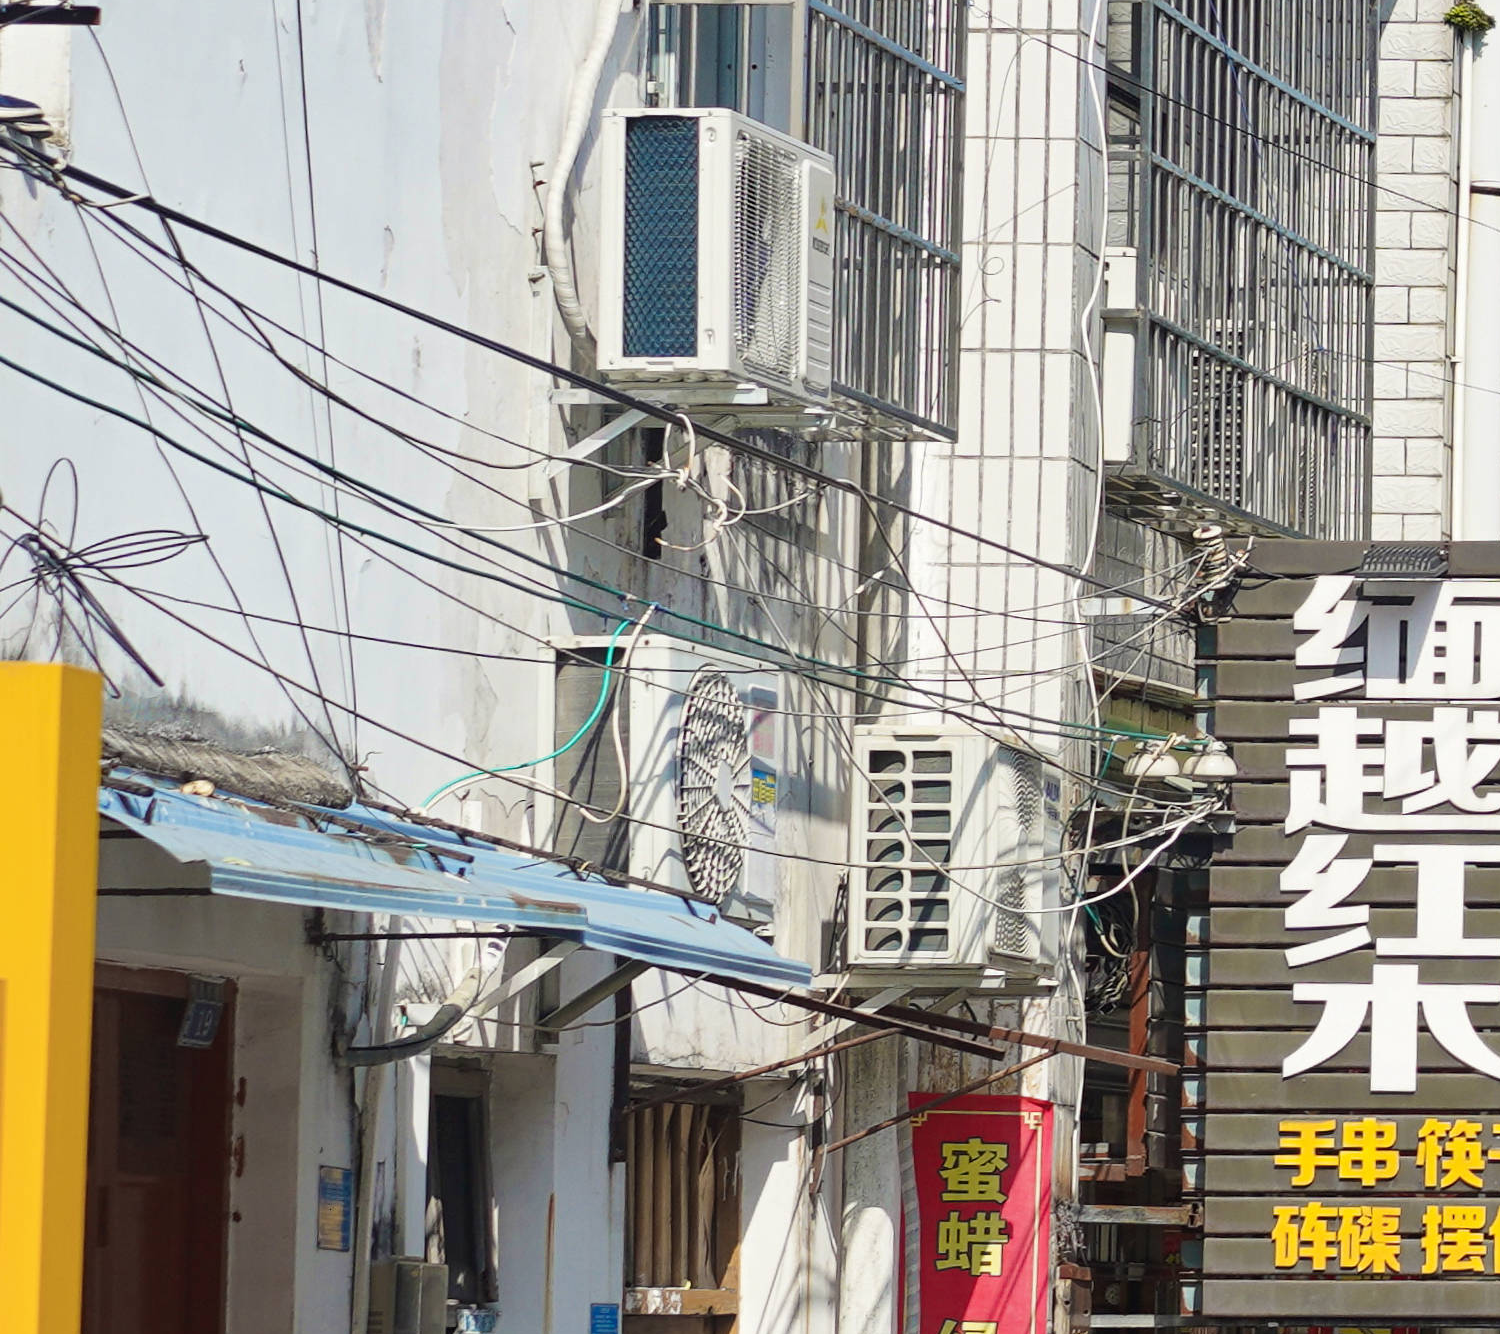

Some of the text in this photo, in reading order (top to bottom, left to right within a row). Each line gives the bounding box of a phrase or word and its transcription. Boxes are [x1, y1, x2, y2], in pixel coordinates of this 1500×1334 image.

[1274, 1116, 1400, 1188] 手串
[934, 1137, 1010, 1278] 蜜蜡
[1272, 1203, 1401, 1273] 砗磲
